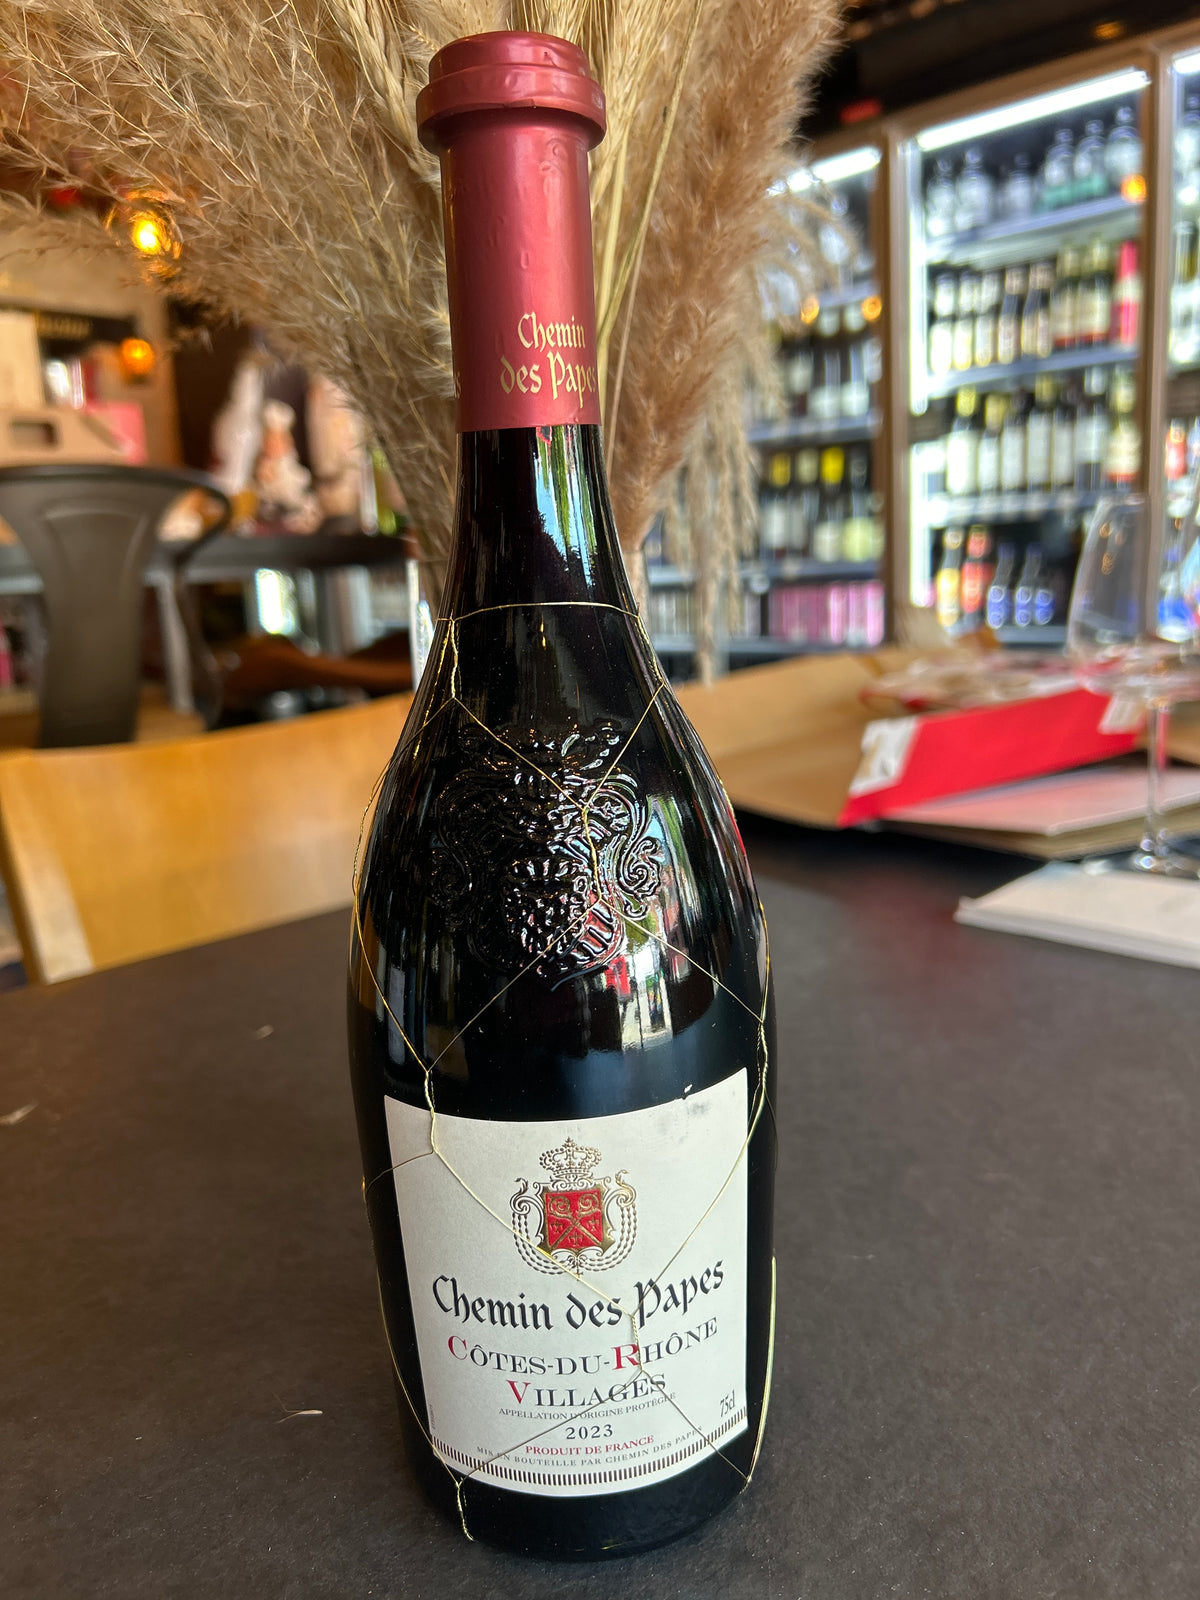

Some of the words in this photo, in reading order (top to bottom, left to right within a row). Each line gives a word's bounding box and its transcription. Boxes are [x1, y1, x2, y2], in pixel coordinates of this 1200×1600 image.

[517, 311, 586, 352] Chemin
[500, 355, 542, 394] des
[547, 350, 596, 409] Papes
[432, 1274, 554, 1331] Chemin
[566, 1292, 623, 1330] des
[633, 1259, 724, 1330] Papes
[447, 1316, 718, 1376] CÔTES-DU-RHÔNE
[505, 1373, 666, 1407] VILLAGES
[719, 1389, 736, 1419] 75cl
[498, 1407, 569, 1421] APPELLATION
[525, 1445, 582, 1456] PRODUIT
[585, 1446, 602, 1455] DE
[605, 1435, 655, 1453] FRANCE
[565, 1424, 613, 1440] 2023
[477, 1446, 494, 1457] MIS
[514, 1456, 577, 1467] BOUTEILLE
[581, 1458, 602, 1467] PAR
[605, 1448, 650, 1464] CHEMIN
[653, 1441, 672, 1454] DES
